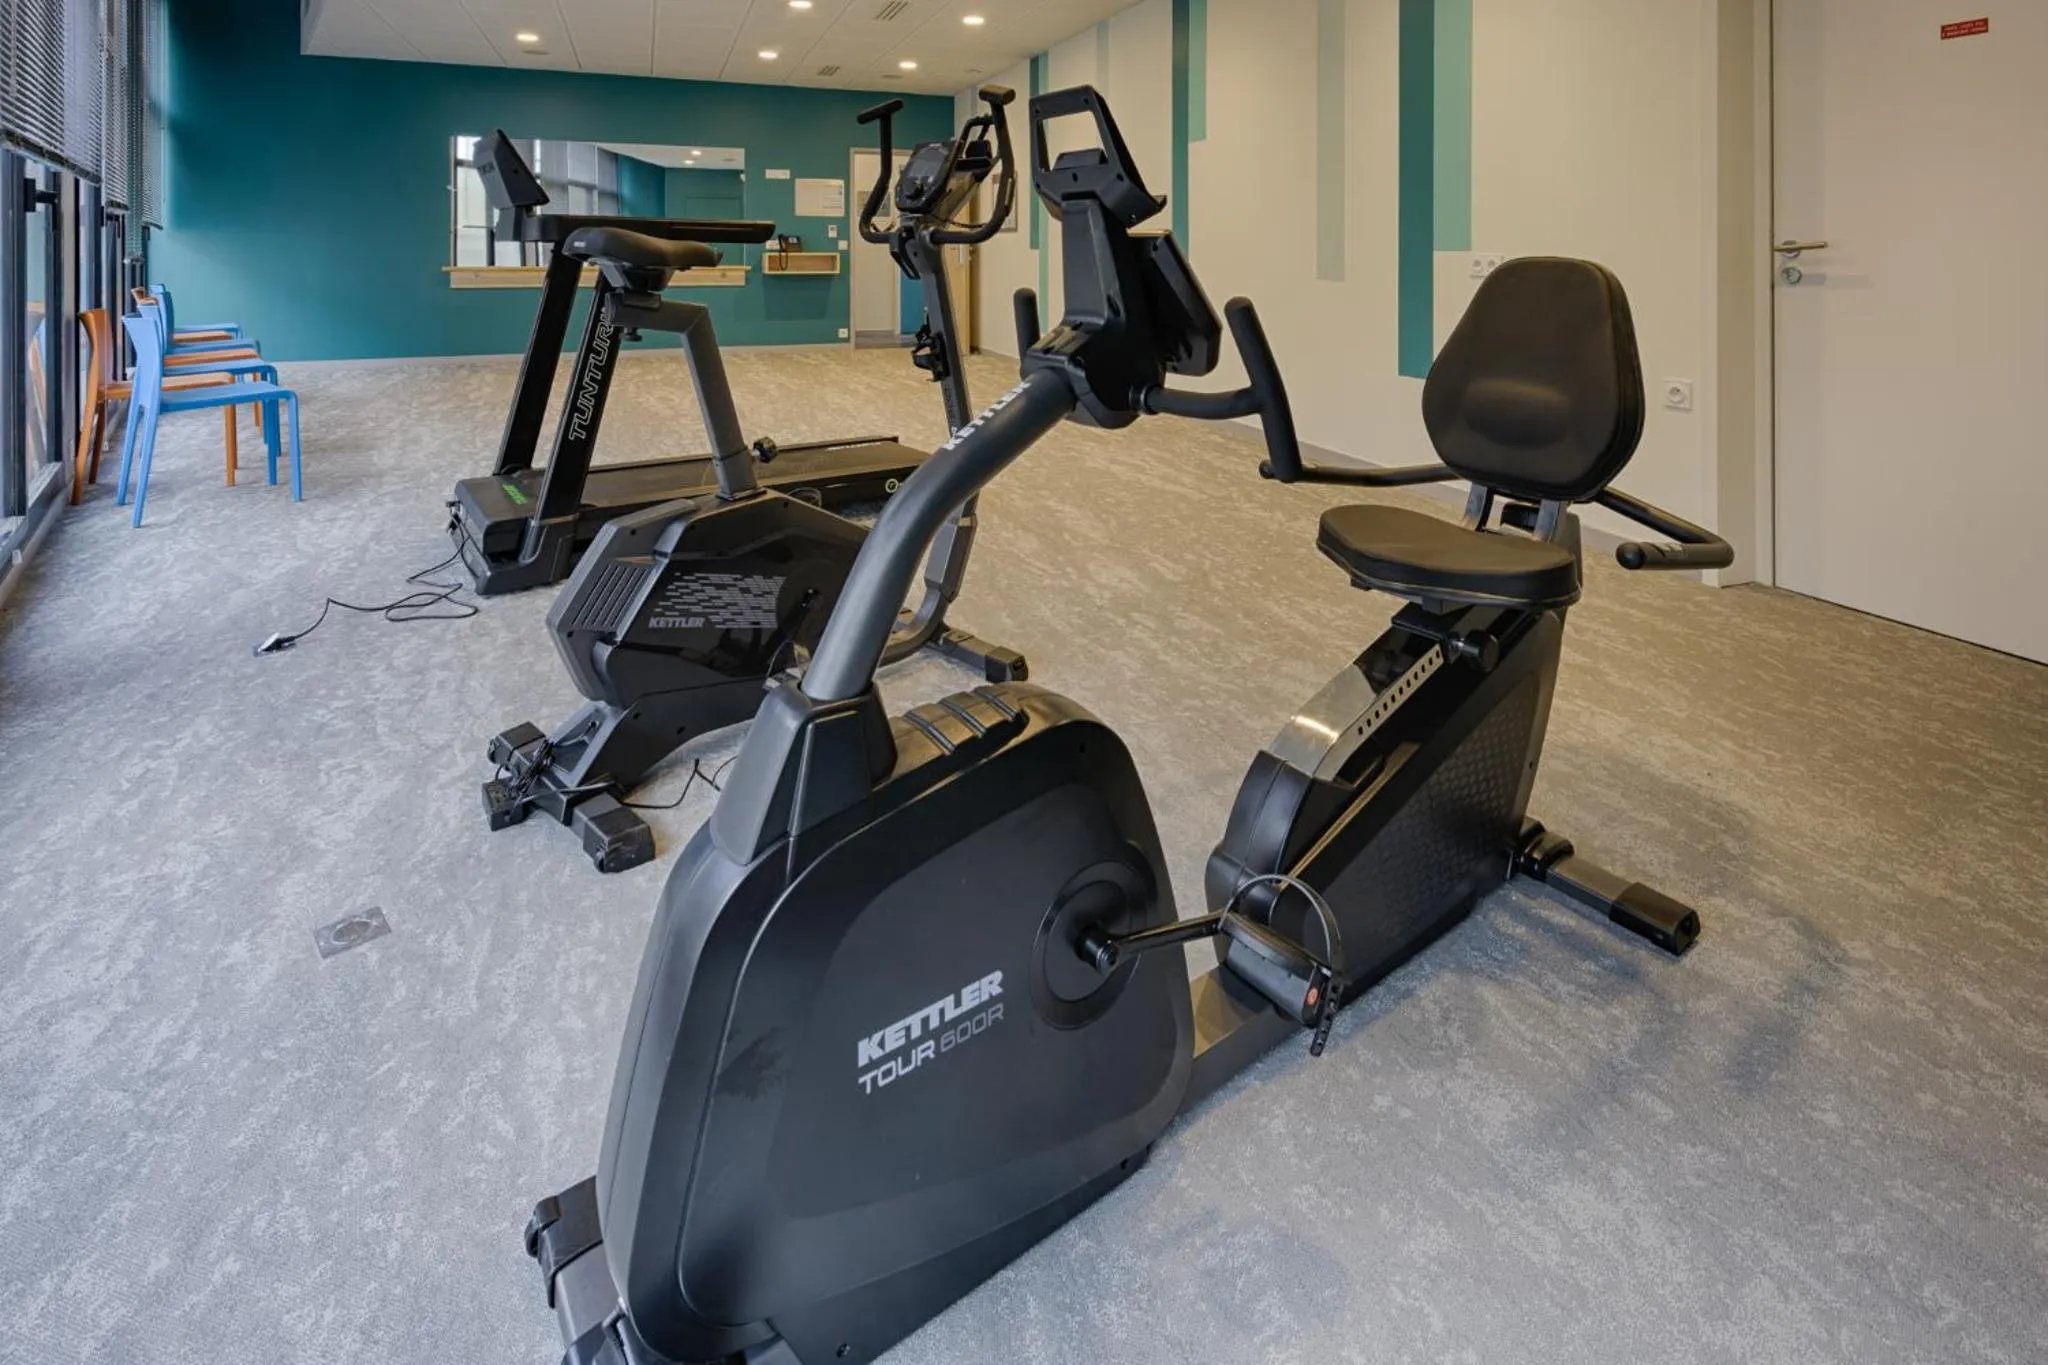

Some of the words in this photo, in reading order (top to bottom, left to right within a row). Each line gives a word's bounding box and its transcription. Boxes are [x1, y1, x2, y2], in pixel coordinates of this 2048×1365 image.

[648, 616, 706, 629] KETTLER
[857, 969, 1004, 1068] KETTLER
[857, 1039, 935, 1095] TOUR
[940, 1002, 1004, 1052] 600R
